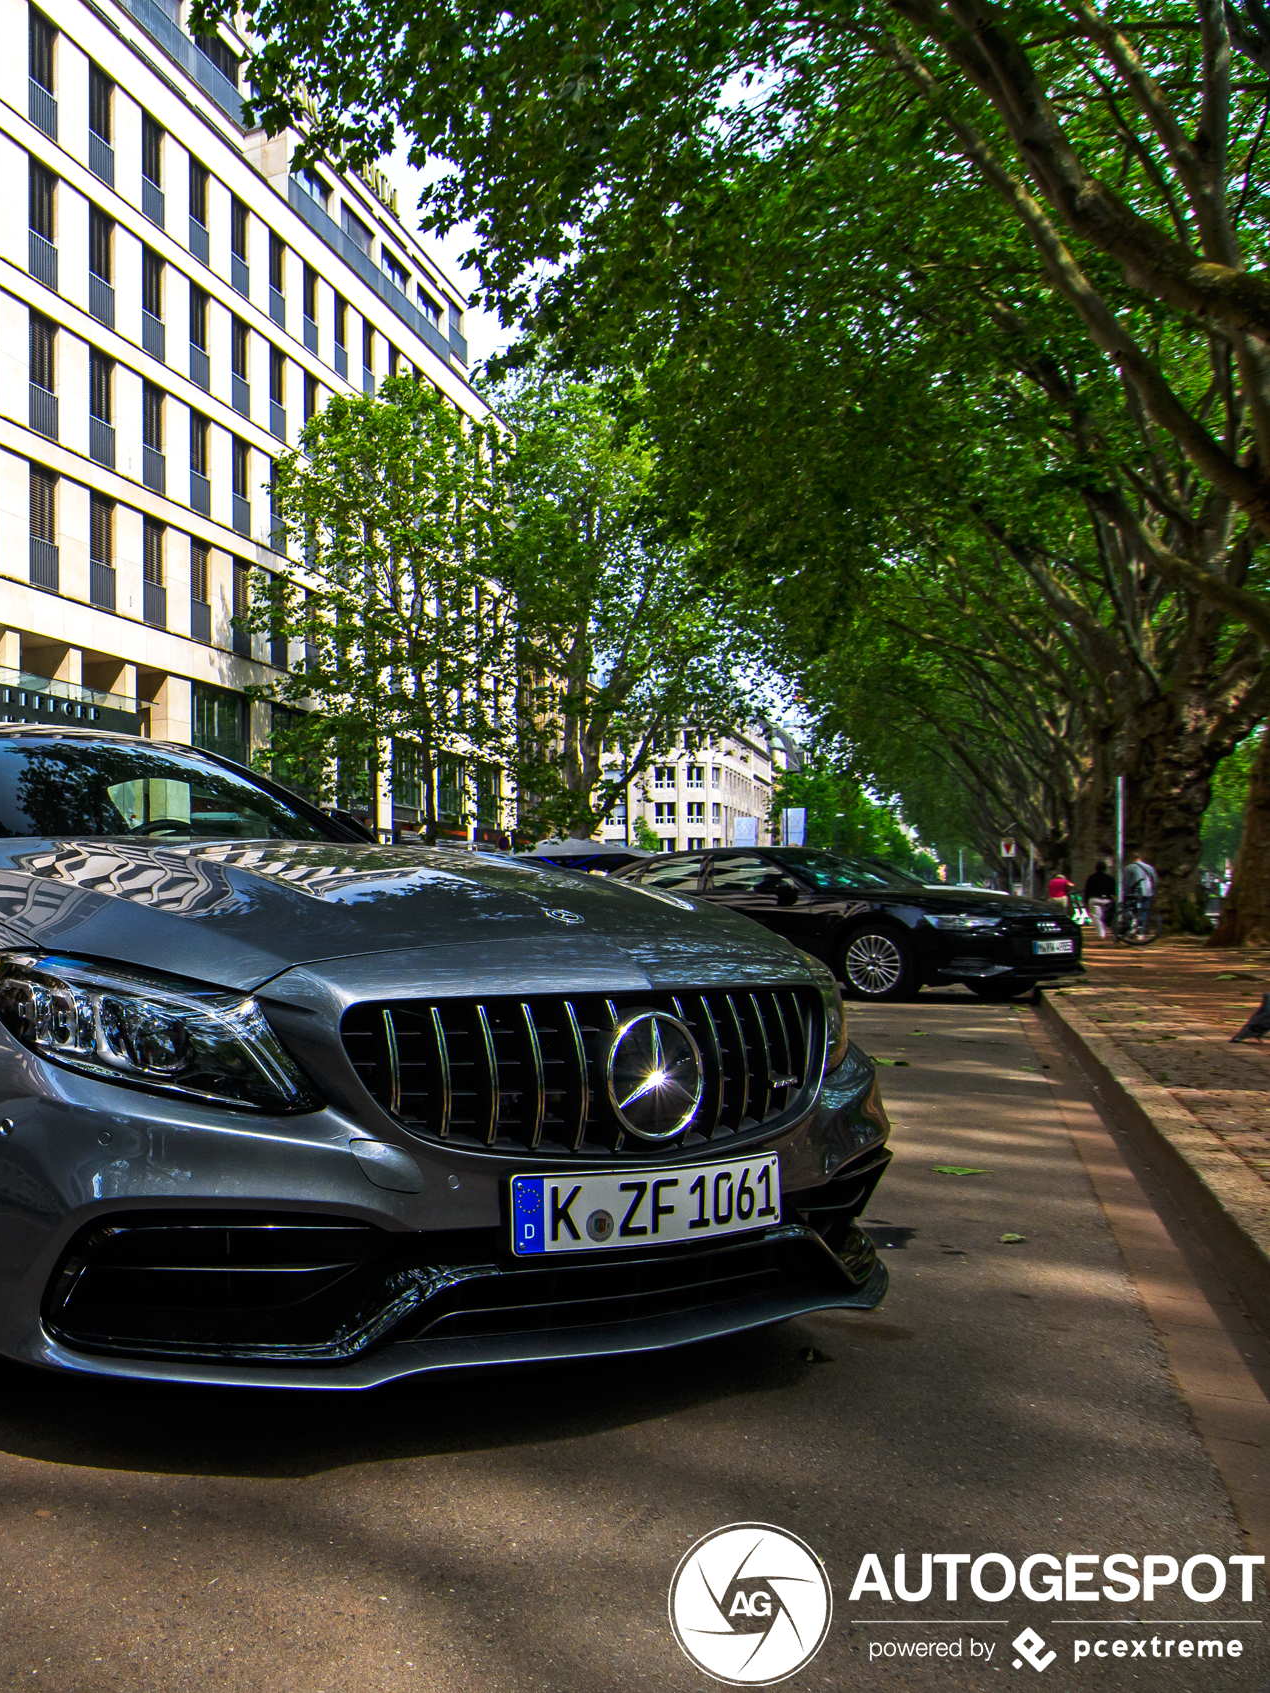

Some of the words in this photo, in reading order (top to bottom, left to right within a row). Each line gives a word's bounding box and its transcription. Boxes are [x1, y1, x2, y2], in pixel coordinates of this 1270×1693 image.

[523, 1223, 536, 1240] D
[550, 1184, 583, 1241] K
[618, 1178, 680, 1237] ZF
[688, 1164, 776, 1229] 1061
